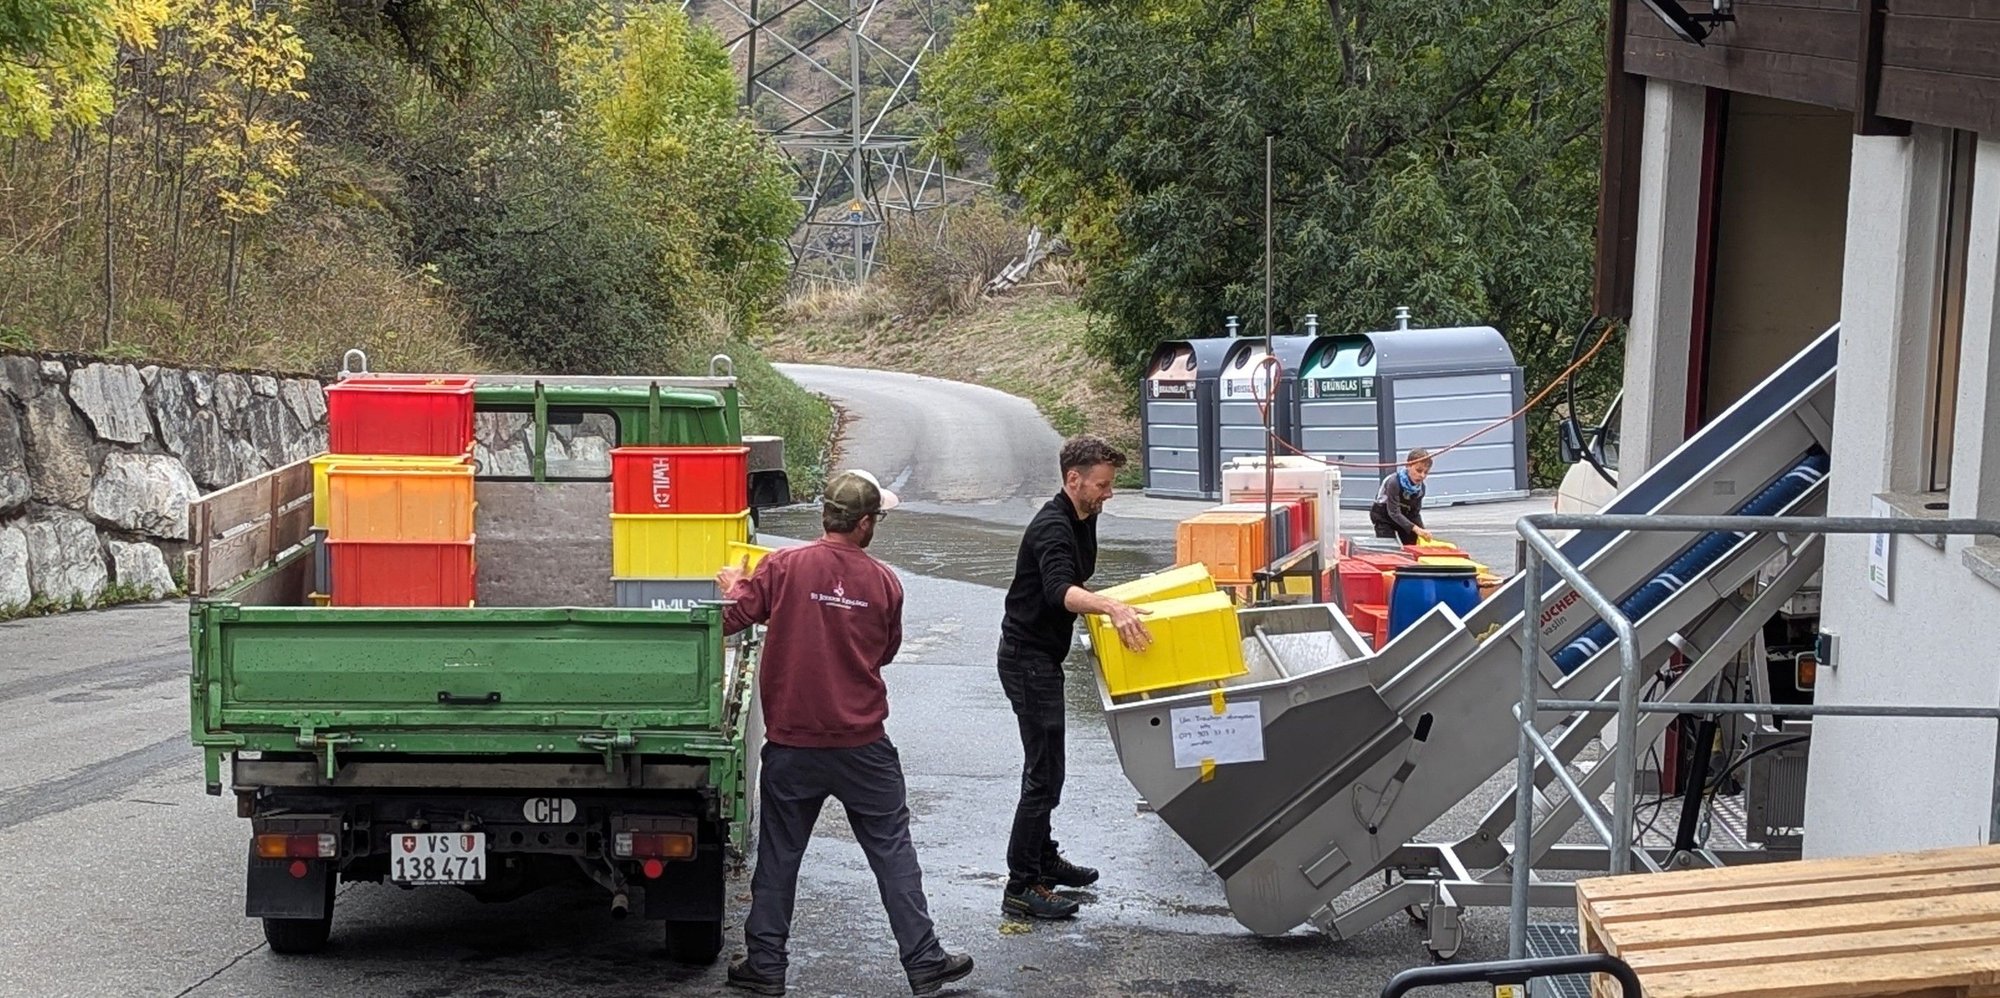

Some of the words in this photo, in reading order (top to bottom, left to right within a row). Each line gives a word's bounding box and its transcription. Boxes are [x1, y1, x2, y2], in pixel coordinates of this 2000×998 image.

[1321, 378, 1358, 392] GRÜNGLAS
[1540, 589, 1581, 628] UCHER
[534, 798, 562, 823] CH
[427, 835, 450, 853] VS
[396, 856, 437, 880] 138
[441, 856, 482, 880] 471
